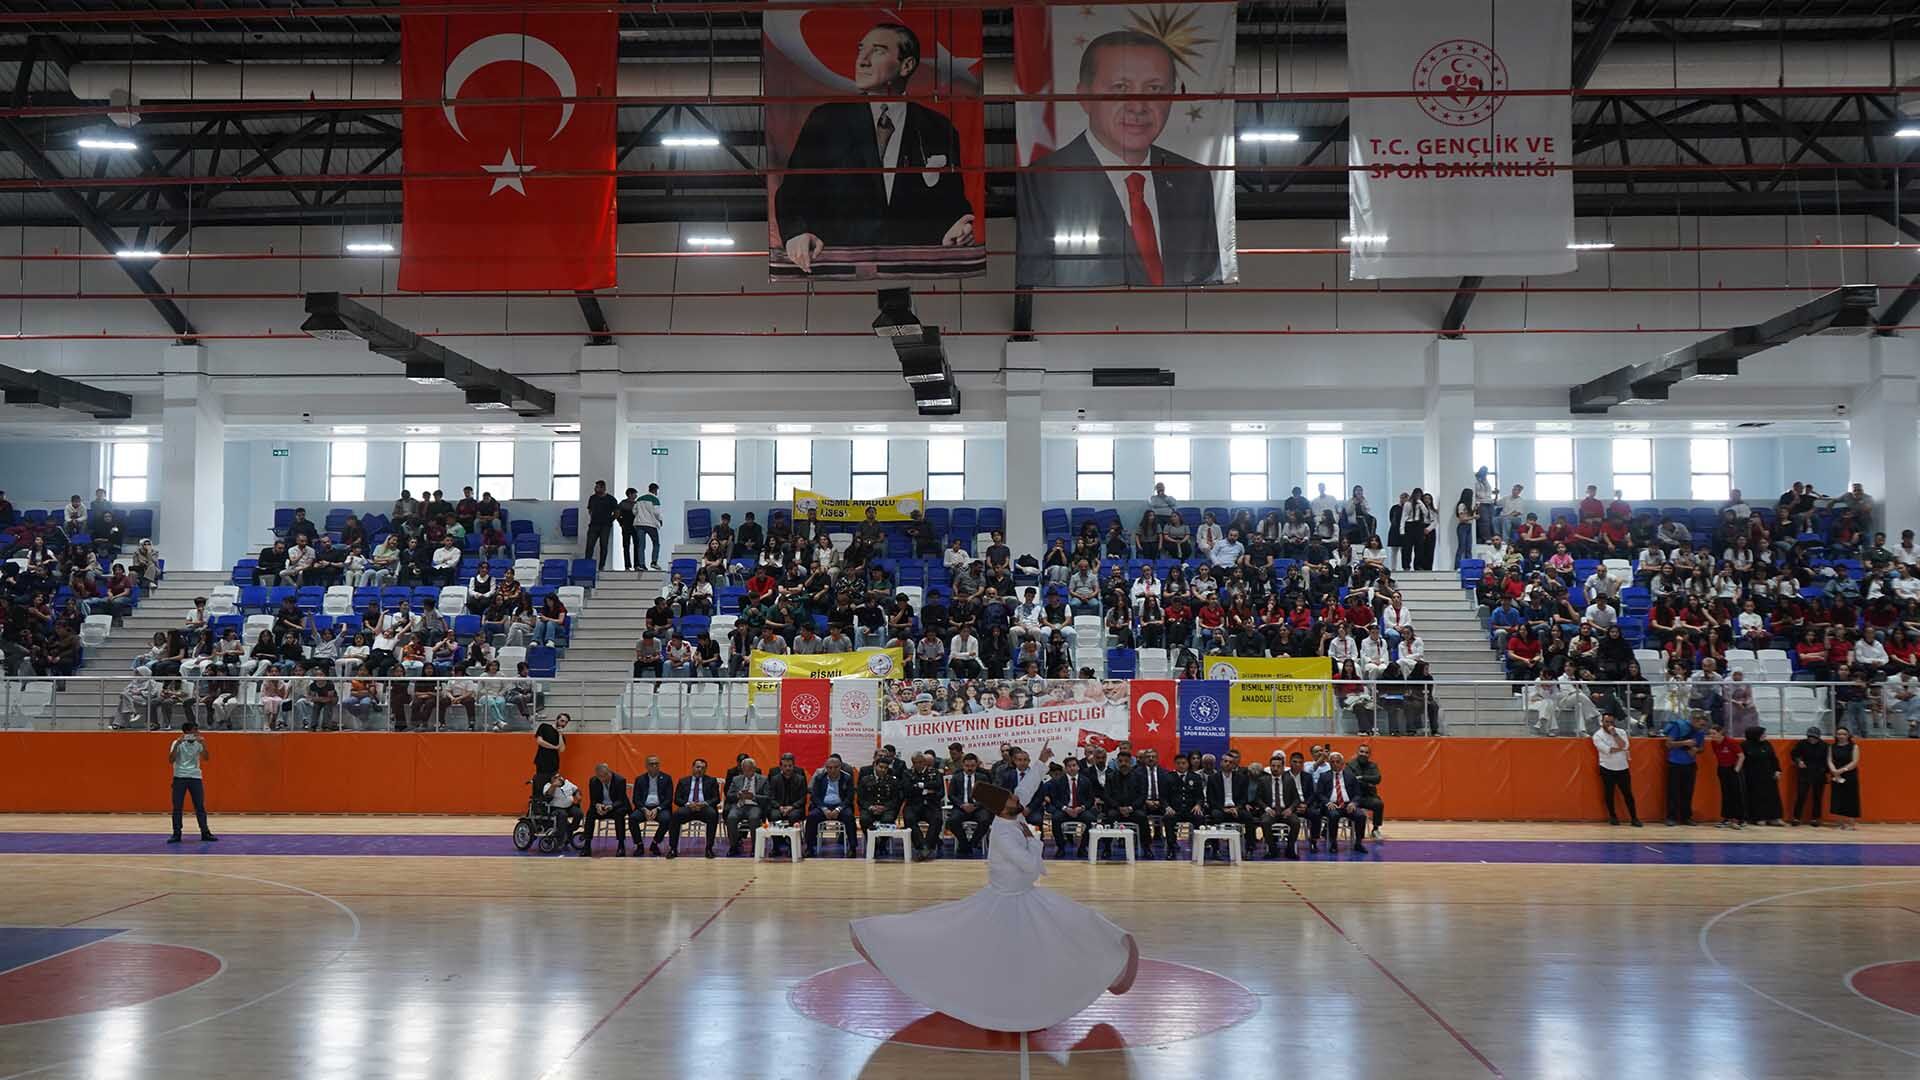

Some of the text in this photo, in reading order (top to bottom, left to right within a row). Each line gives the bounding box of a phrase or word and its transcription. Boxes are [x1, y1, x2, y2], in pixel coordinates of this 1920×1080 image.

[1369, 134, 1555, 159] T.C. GENÇLİK VE
[1369, 157, 1555, 179] SPOR BAKANLIĞI
[852, 499, 896, 507] ANADOLU
[810, 668, 842, 679] BİSMİL
[1294, 683, 1303, 691] VE
[1241, 694, 1294, 703] ANADOLU İSESİ
